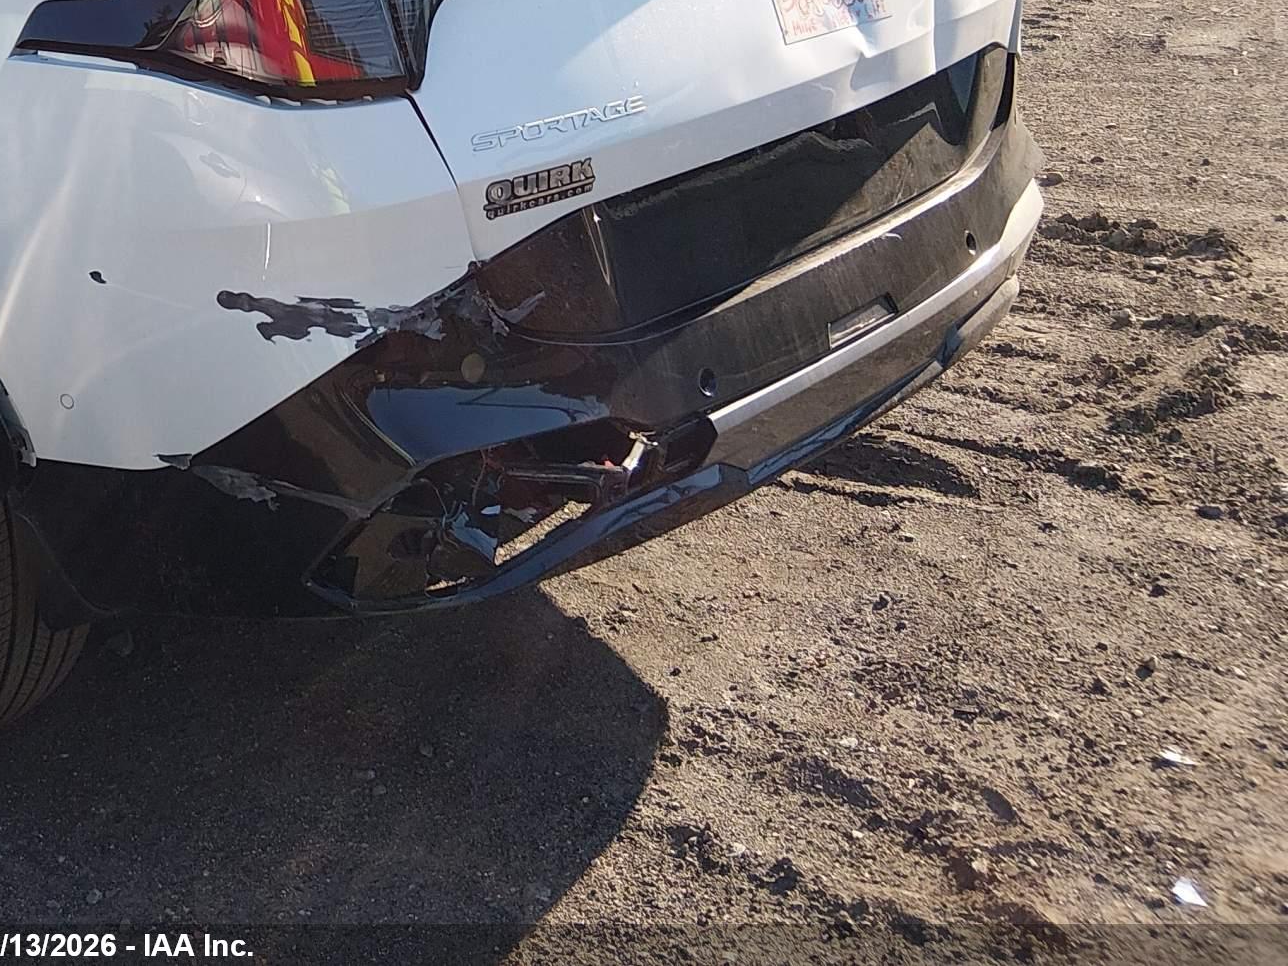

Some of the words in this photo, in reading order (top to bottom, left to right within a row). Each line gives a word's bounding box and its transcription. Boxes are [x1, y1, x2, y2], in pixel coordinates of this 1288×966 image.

[471, 95, 647, 152] SPORTAGE
[486, 157, 595, 204] QUIRK
[486, 185, 594, 220] quirkcars.com
